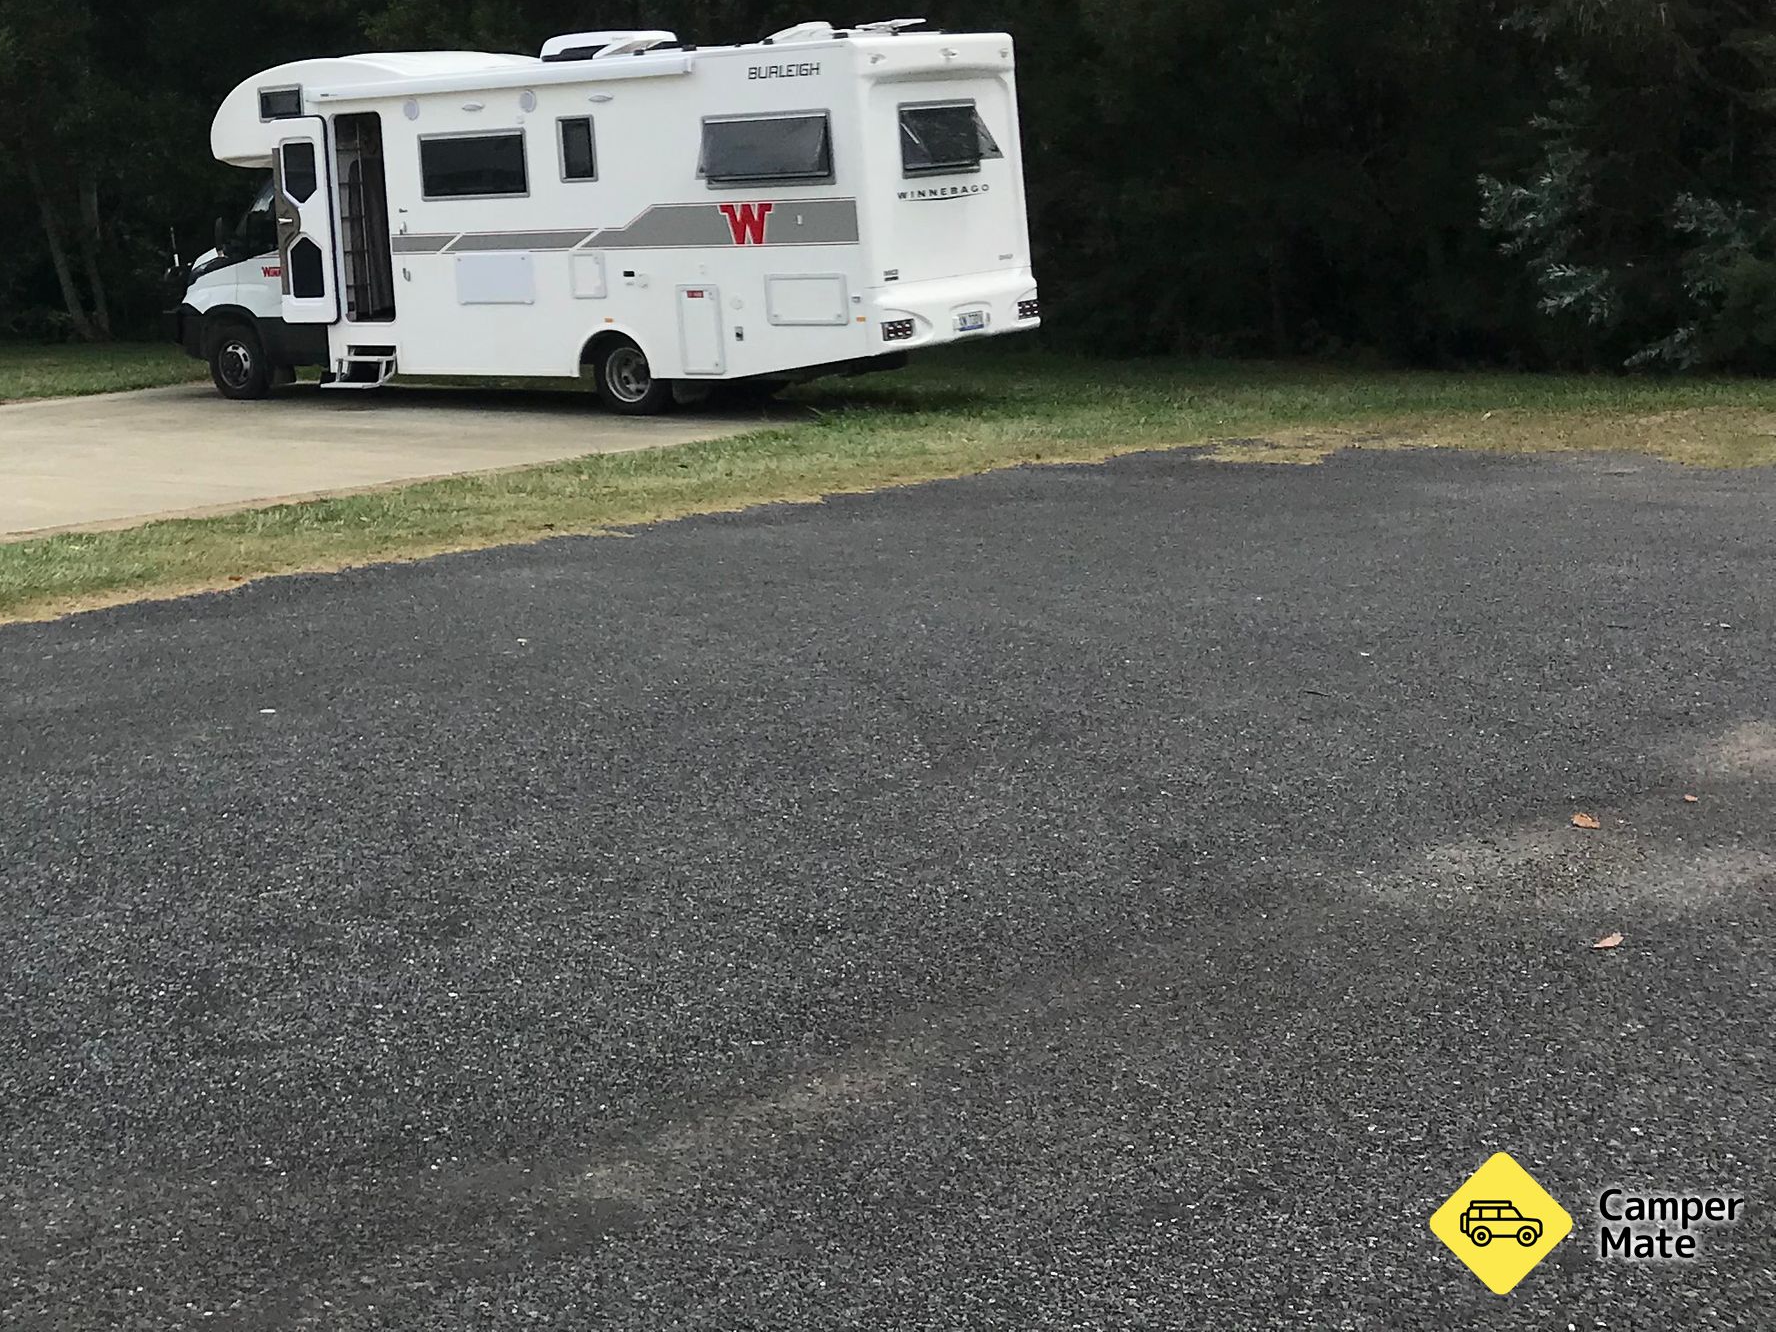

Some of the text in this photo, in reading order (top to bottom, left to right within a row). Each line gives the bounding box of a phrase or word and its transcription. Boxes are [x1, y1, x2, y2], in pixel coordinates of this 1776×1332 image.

[748, 62, 821, 79] BURLEIGH
[897, 184, 989, 199] WINNEBAGO
[718, 203, 773, 245] W
